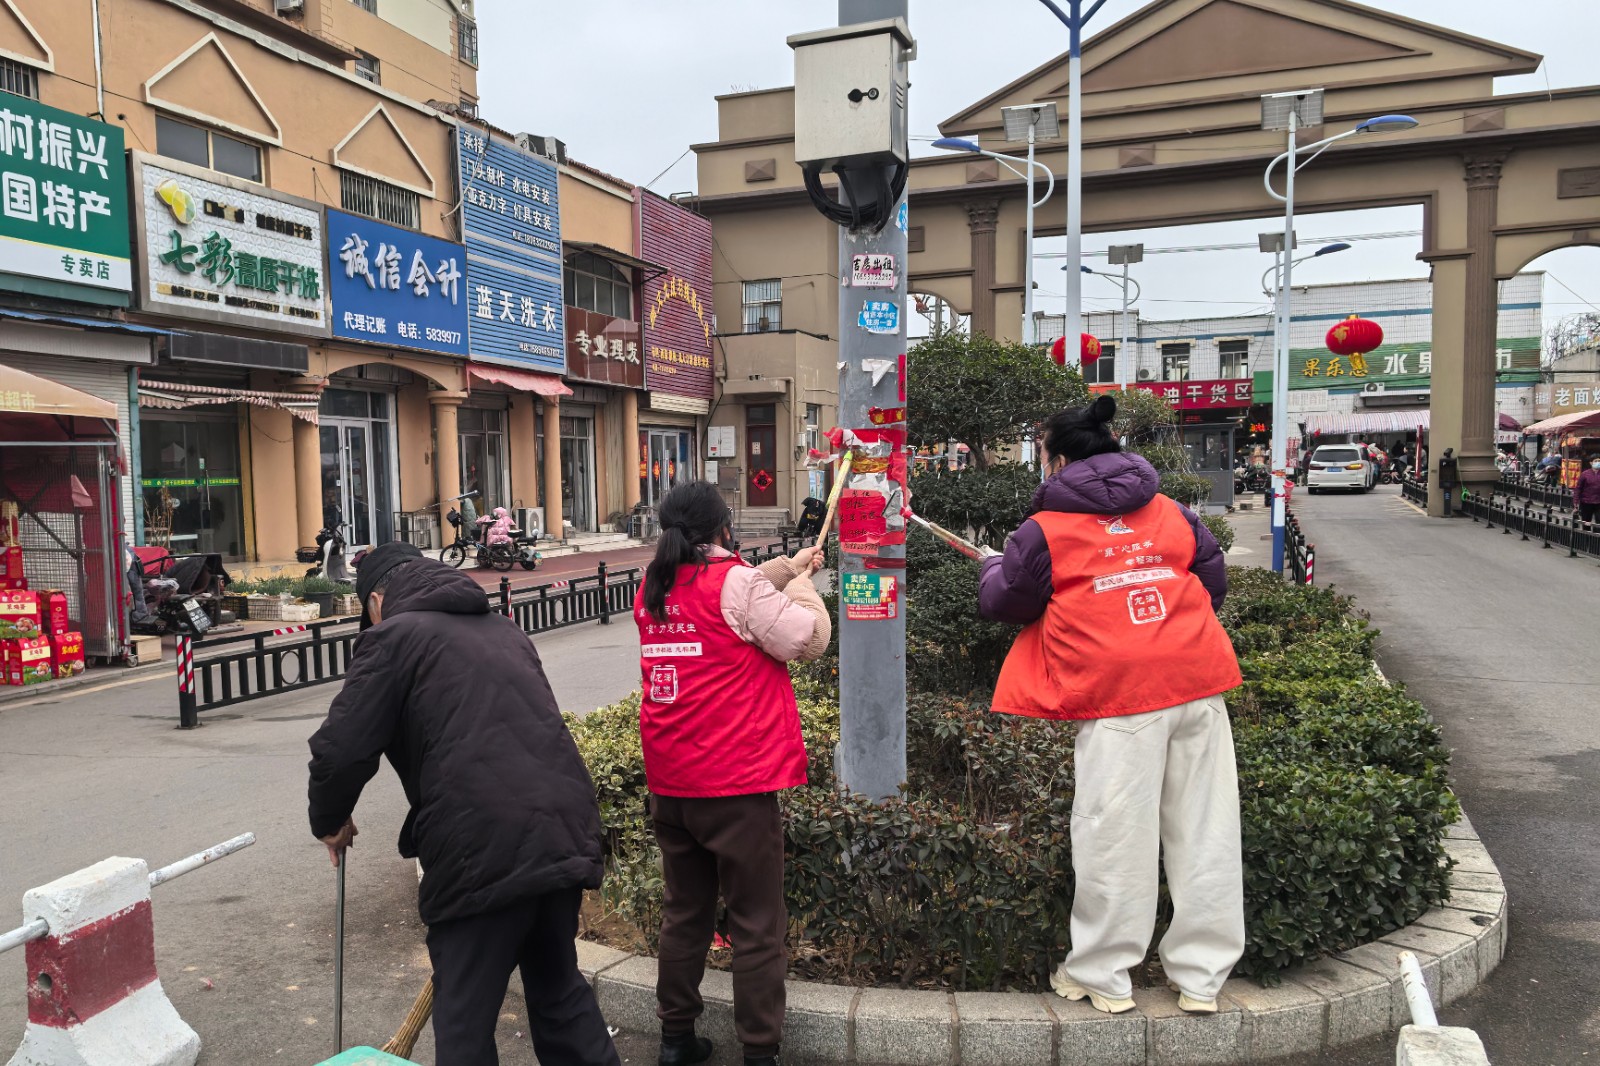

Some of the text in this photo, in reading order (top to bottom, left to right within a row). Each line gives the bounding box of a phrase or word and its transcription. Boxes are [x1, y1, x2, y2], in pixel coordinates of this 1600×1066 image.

[464, 131, 484, 154] 承接
[2, 170, 111, 232] 国特产
[465, 157, 550, 206] 门头制作 水电安装
[467, 186, 552, 231] 亚克力字 灯具安装
[61, 254, 110, 280] 专卖店
[339, 233, 462, 305] 诚信会计
[853, 256, 893, 271] 吉房出租
[343, 311, 387, 334] 代理记账
[475, 284, 556, 333] 蓝天洗衣
[574, 330, 640, 365] 专业理发
